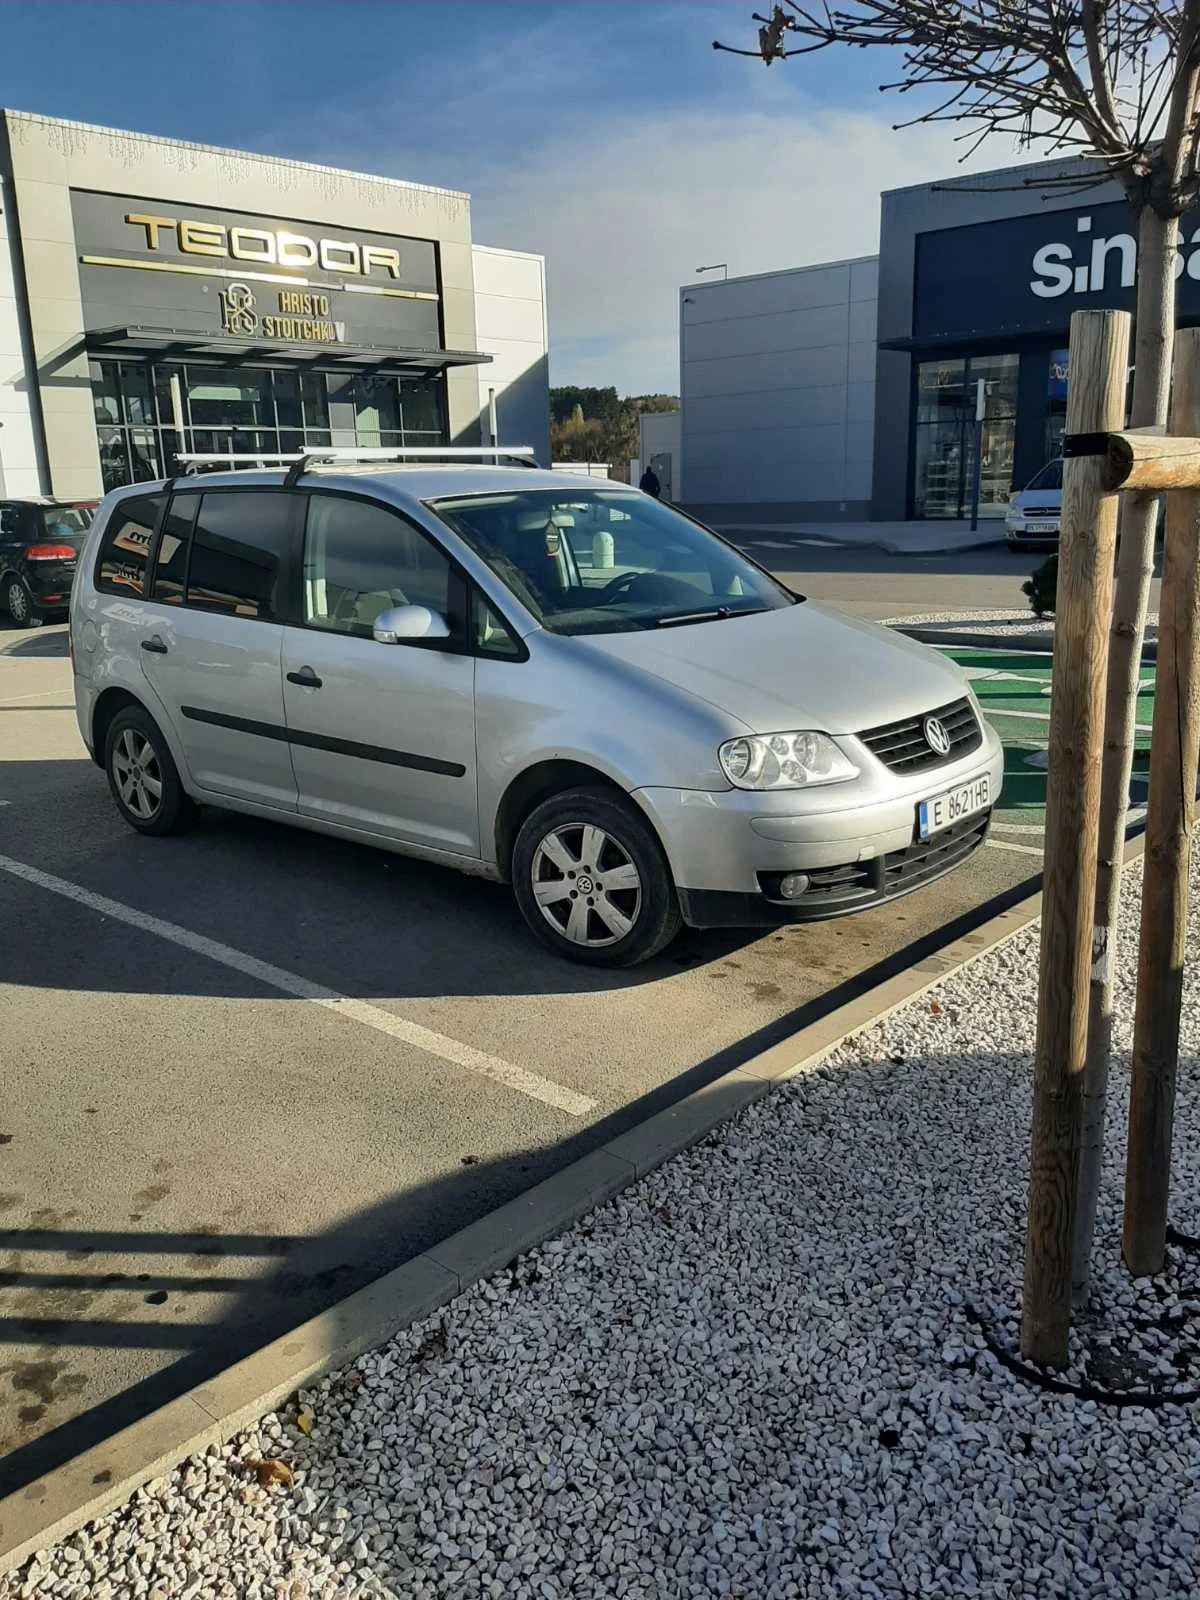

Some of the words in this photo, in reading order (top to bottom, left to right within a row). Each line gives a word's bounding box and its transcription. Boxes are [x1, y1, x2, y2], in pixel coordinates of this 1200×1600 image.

[125, 213, 400, 279] TEODOR
[1030, 216, 1200, 298] sin
[279, 291, 329, 317] HRISTO
[934, 801, 943, 826] E
